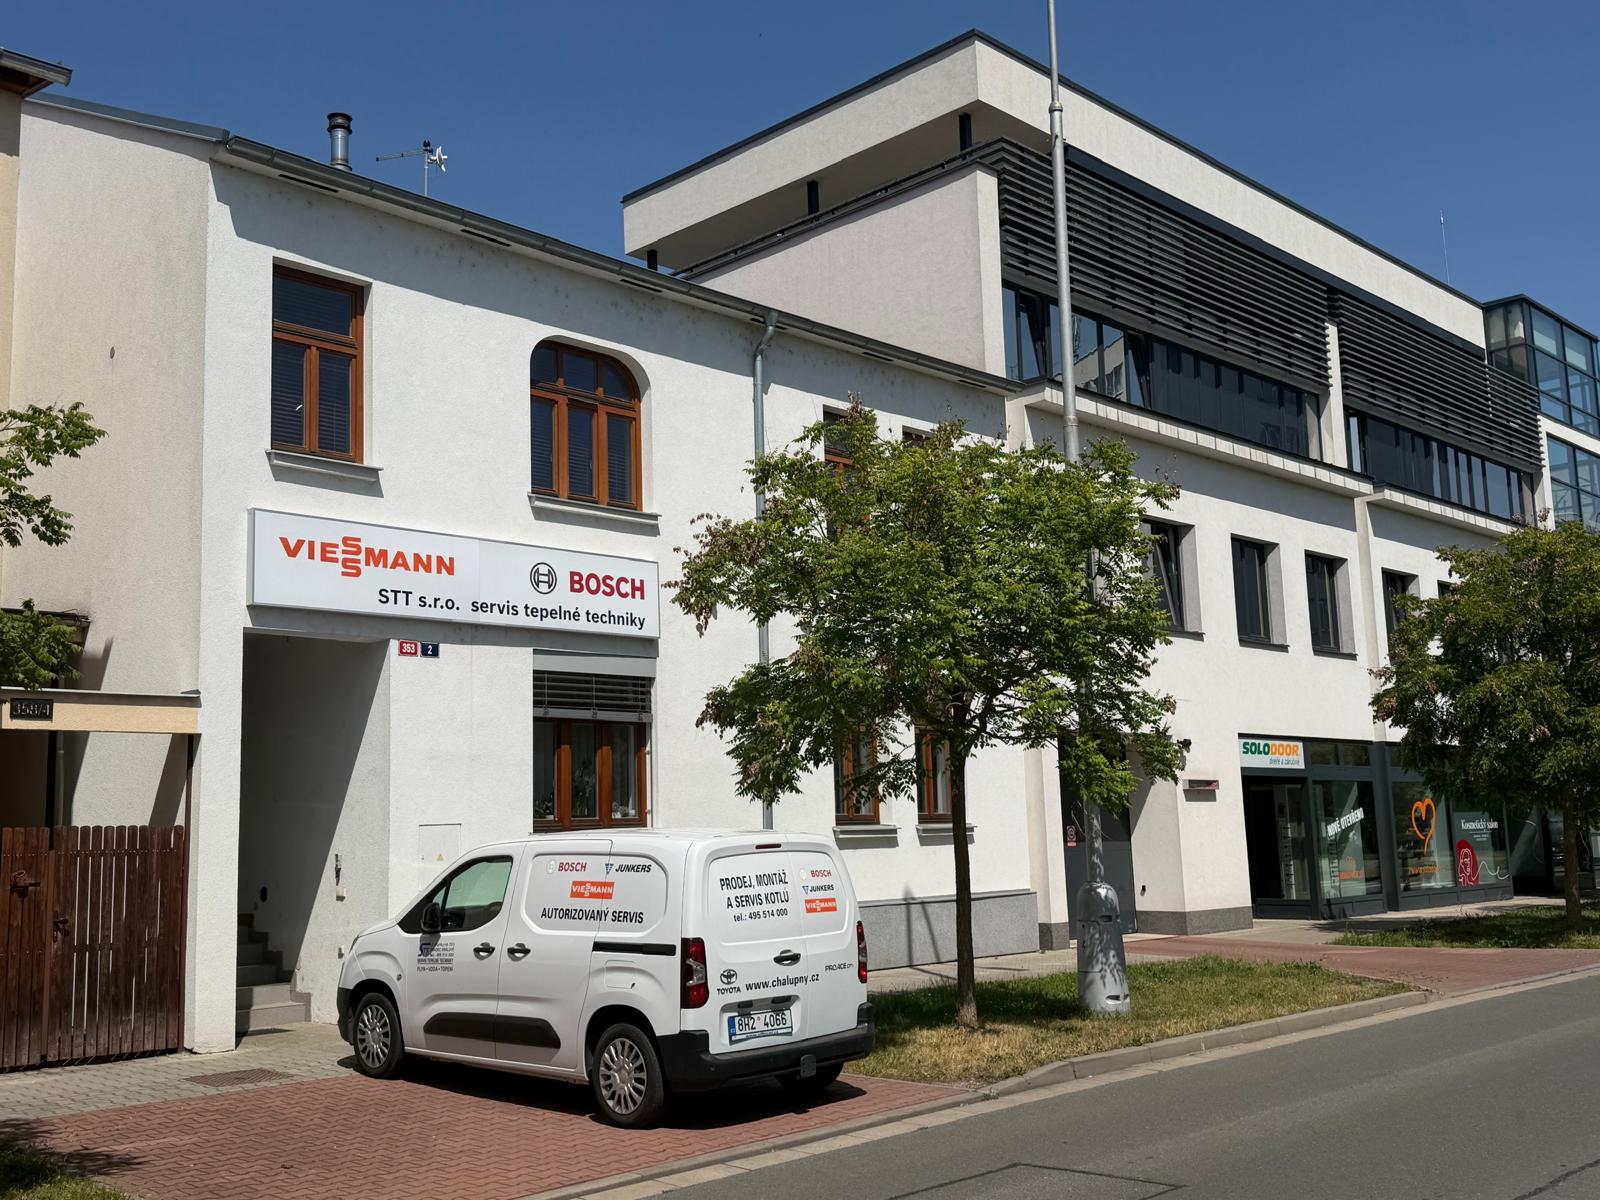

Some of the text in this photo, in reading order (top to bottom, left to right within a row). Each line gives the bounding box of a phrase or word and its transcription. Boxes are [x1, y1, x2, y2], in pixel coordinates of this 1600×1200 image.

[278, 535, 455, 578] VIESSMANN
[569, 570, 645, 600] BOSCH
[378, 588, 646, 630] STT s.r.o. servis tepelné techniky
[402, 643, 416, 654] 353
[427, 645, 433, 655] 2
[1242, 741, 1299, 756] SOLODOOR
[558, 862, 587, 873] BOSCH
[615, 863, 652, 873] JUNKERS
[810, 869, 832, 878] BOSCH
[719, 869, 788, 891] PRODEJ, MONTÁŽ
[572, 882, 613, 897] VIESSMANN
[809, 884, 834, 893] JUNKERS
[727, 897, 733, 909] A
[735, 894, 764, 908] SERVIS
[541, 907, 644, 924] AUTORIZOVANÝ SERVIS
[733, 908, 788, 922] tel.: 495 514 000
[745, 973, 820, 991] www.chalupny.cz
[717, 986, 741, 995] TOYOTA
[737, 1012, 787, 1032] 8H2 4066
